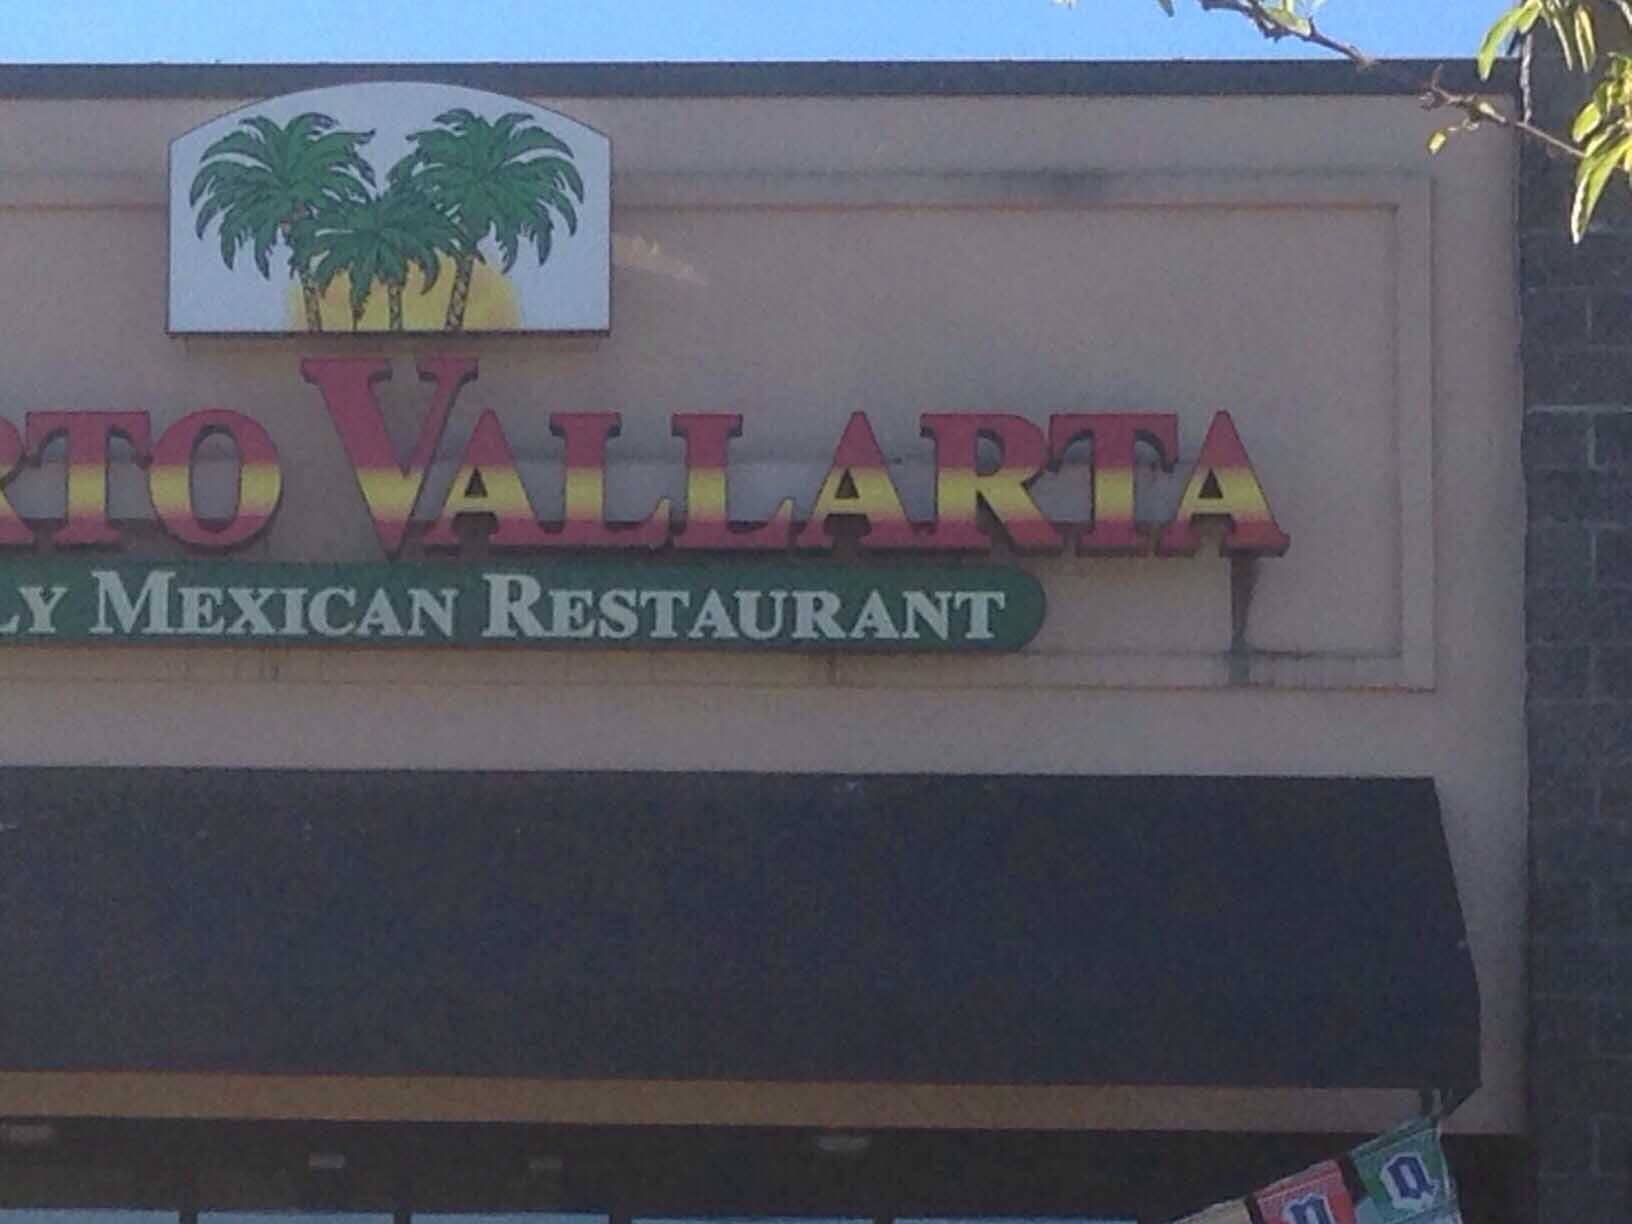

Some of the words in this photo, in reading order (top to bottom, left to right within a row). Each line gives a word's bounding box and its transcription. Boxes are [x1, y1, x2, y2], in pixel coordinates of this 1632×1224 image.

[301, 356, 1290, 561] VALLARTA
[89, 567, 458, 637] MEXICAN
[482, 571, 1006, 640] RESTAURANT
